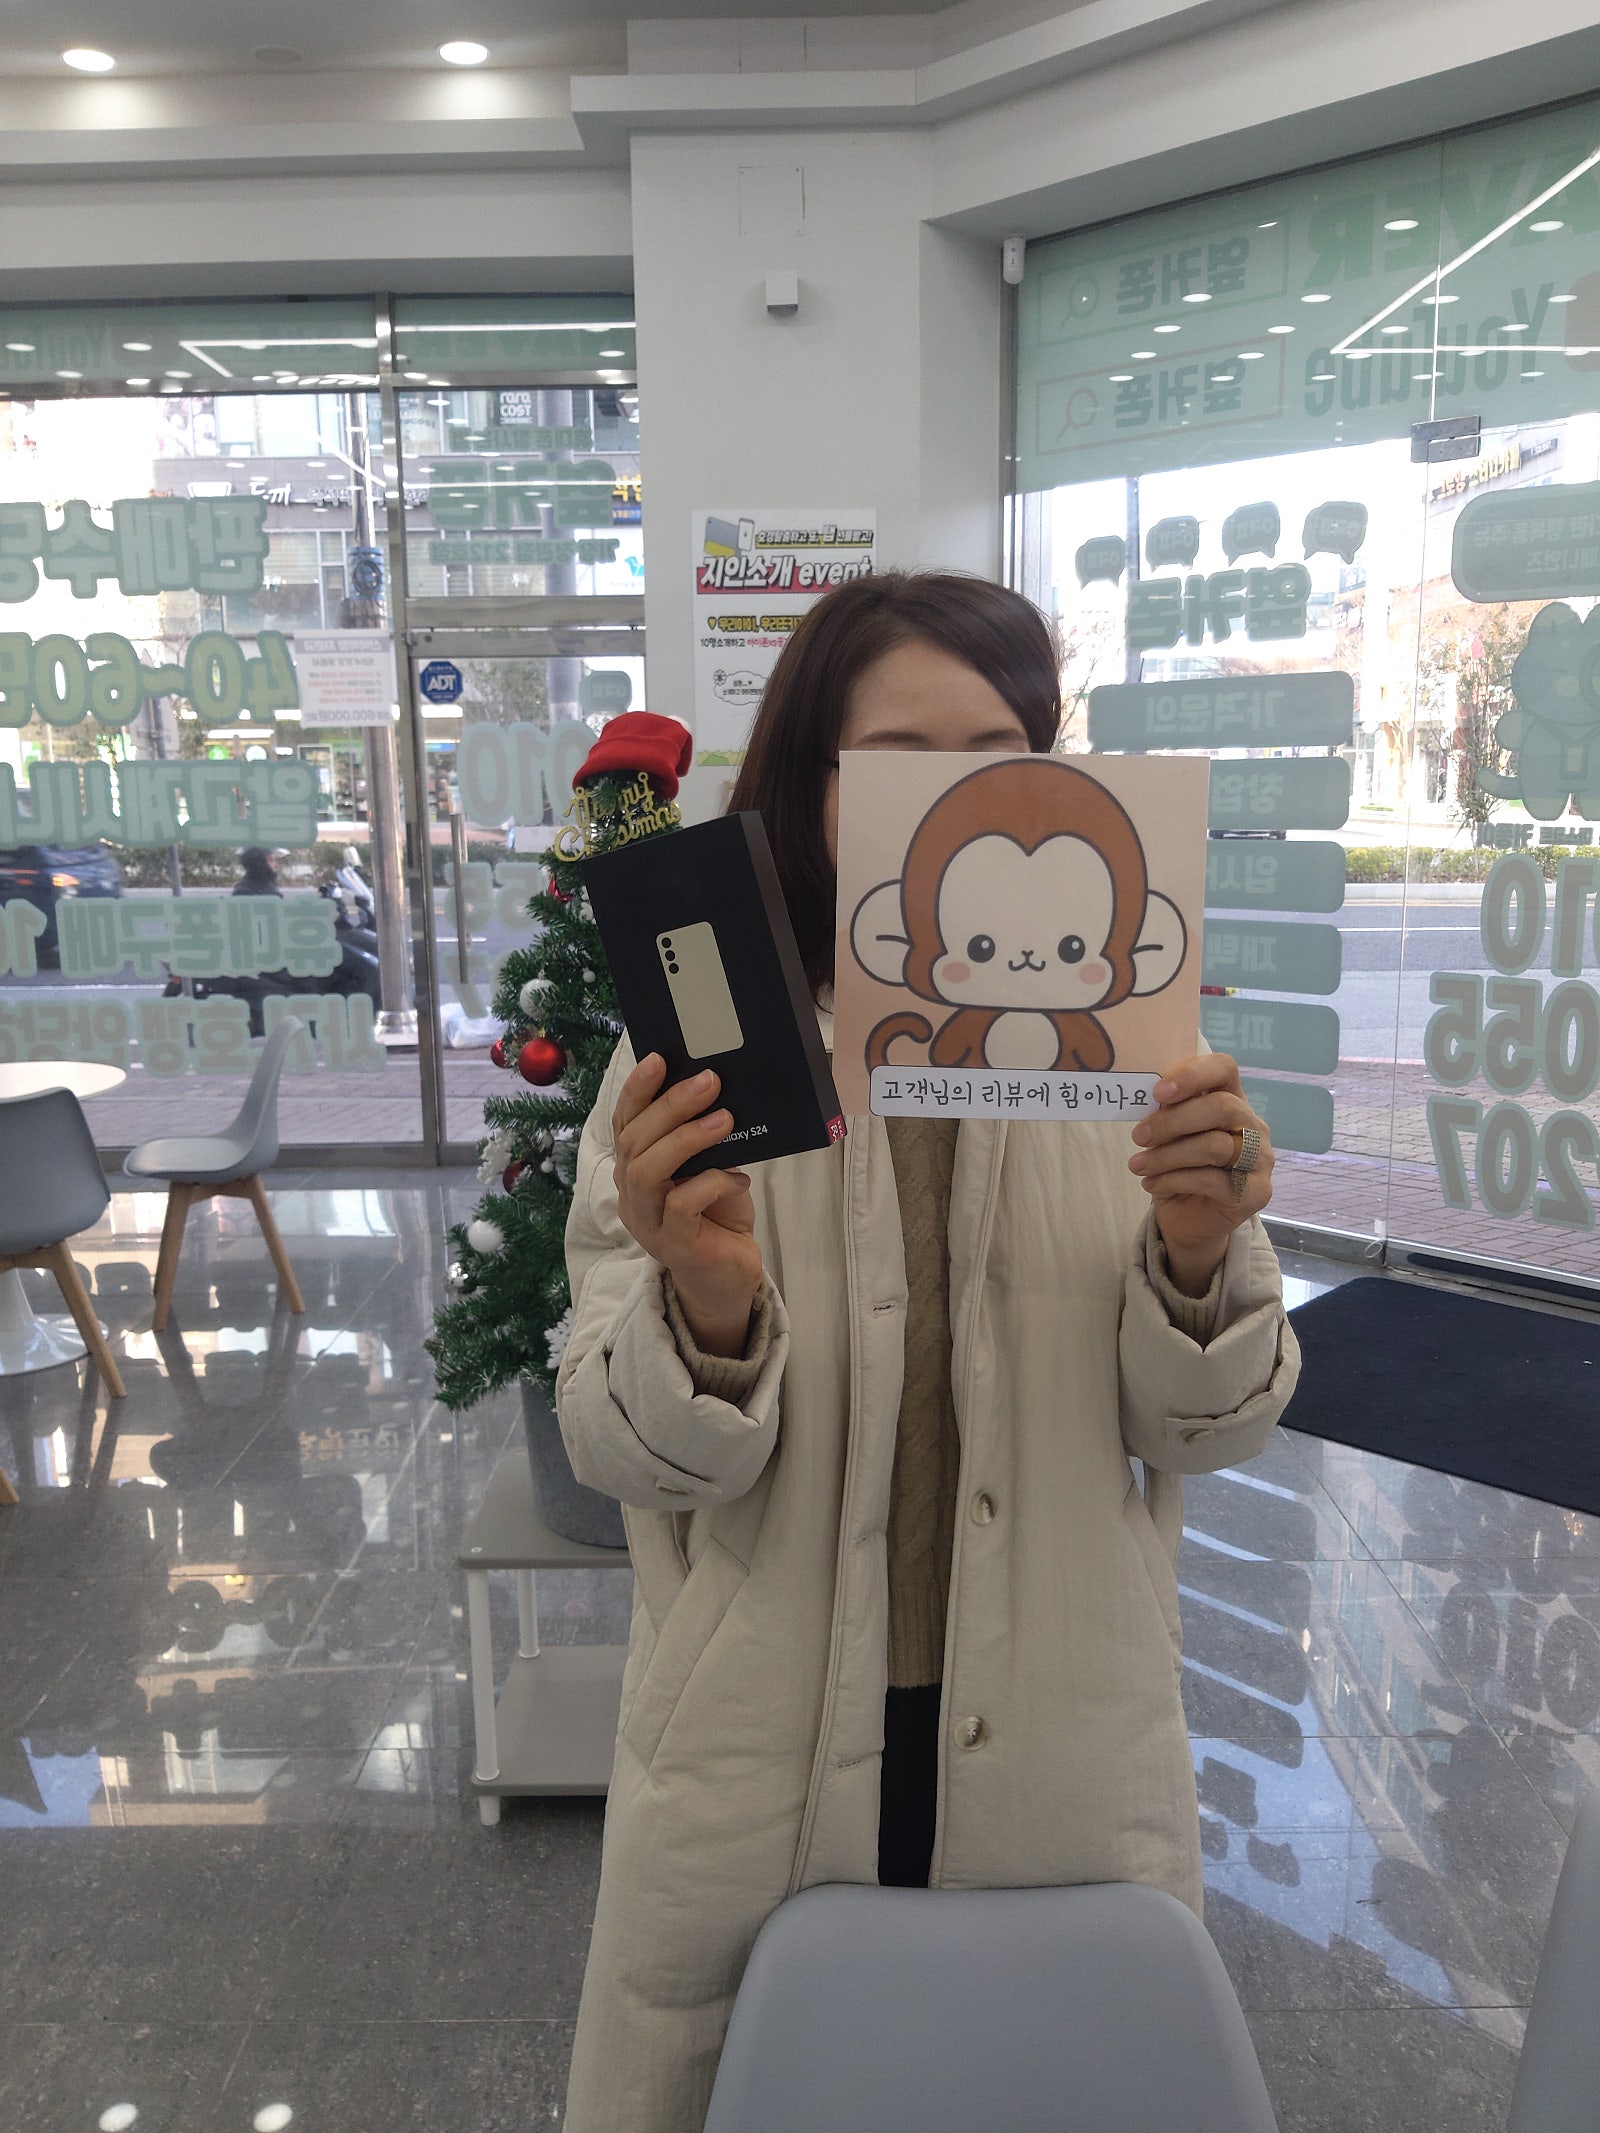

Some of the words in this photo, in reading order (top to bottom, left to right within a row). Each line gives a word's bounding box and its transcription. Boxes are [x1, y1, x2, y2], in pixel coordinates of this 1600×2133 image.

[501, 404, 532, 417] COST
[700, 555, 796, 588] 지인소개
[426, 674, 457, 692] ADT
[881, 1078, 972, 1106] 고객님의
[981, 1079, 1050, 1108] 리뷰에
[1058, 1081, 1150, 1111] 힘이나요
[717, 1129, 749, 1145] alaxy
[750, 1124, 769, 1138] S24
